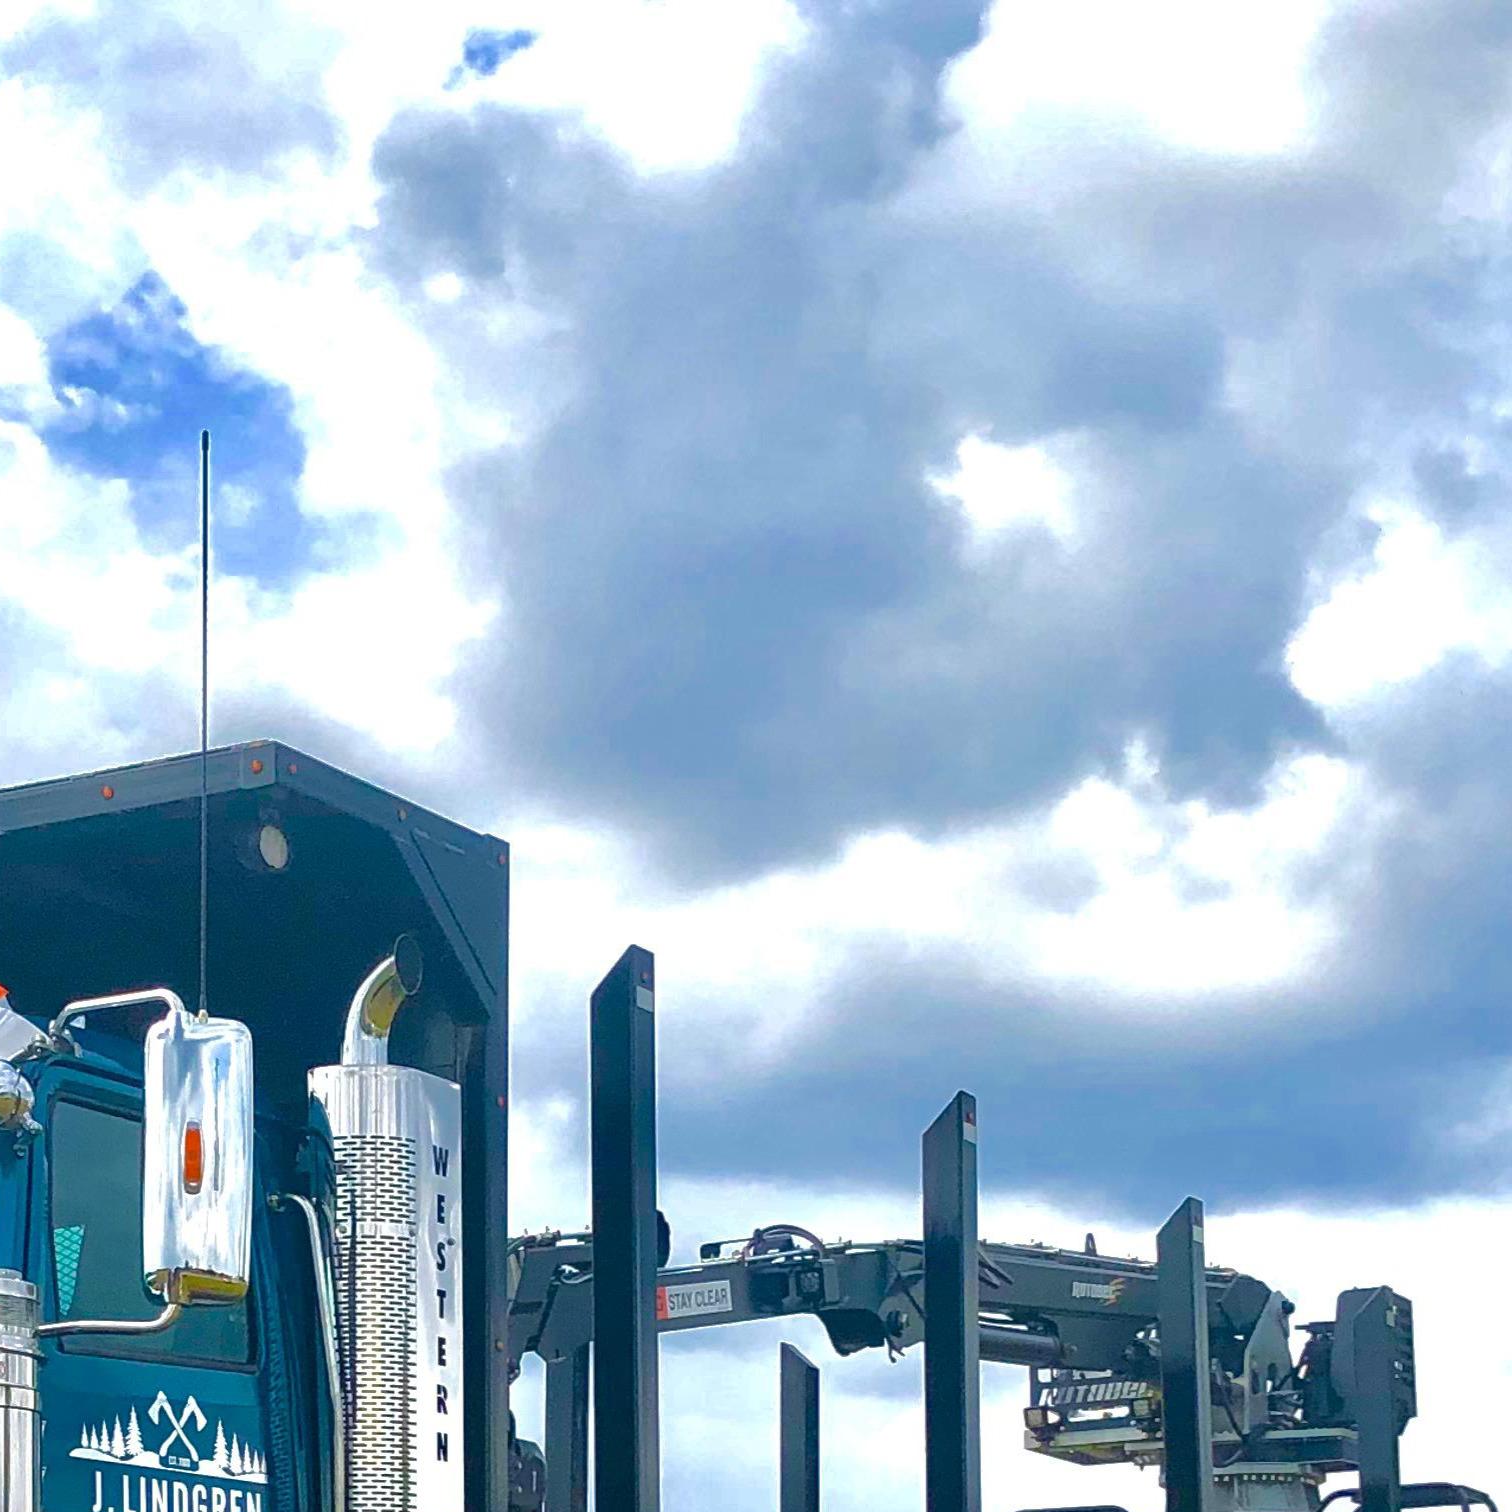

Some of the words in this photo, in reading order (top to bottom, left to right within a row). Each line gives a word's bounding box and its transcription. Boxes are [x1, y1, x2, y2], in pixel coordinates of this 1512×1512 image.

[432, 1144, 450, 1463] WESTERN
[668, 1291, 694, 1312] STAY
[694, 1287, 728, 1308] CLEAR
